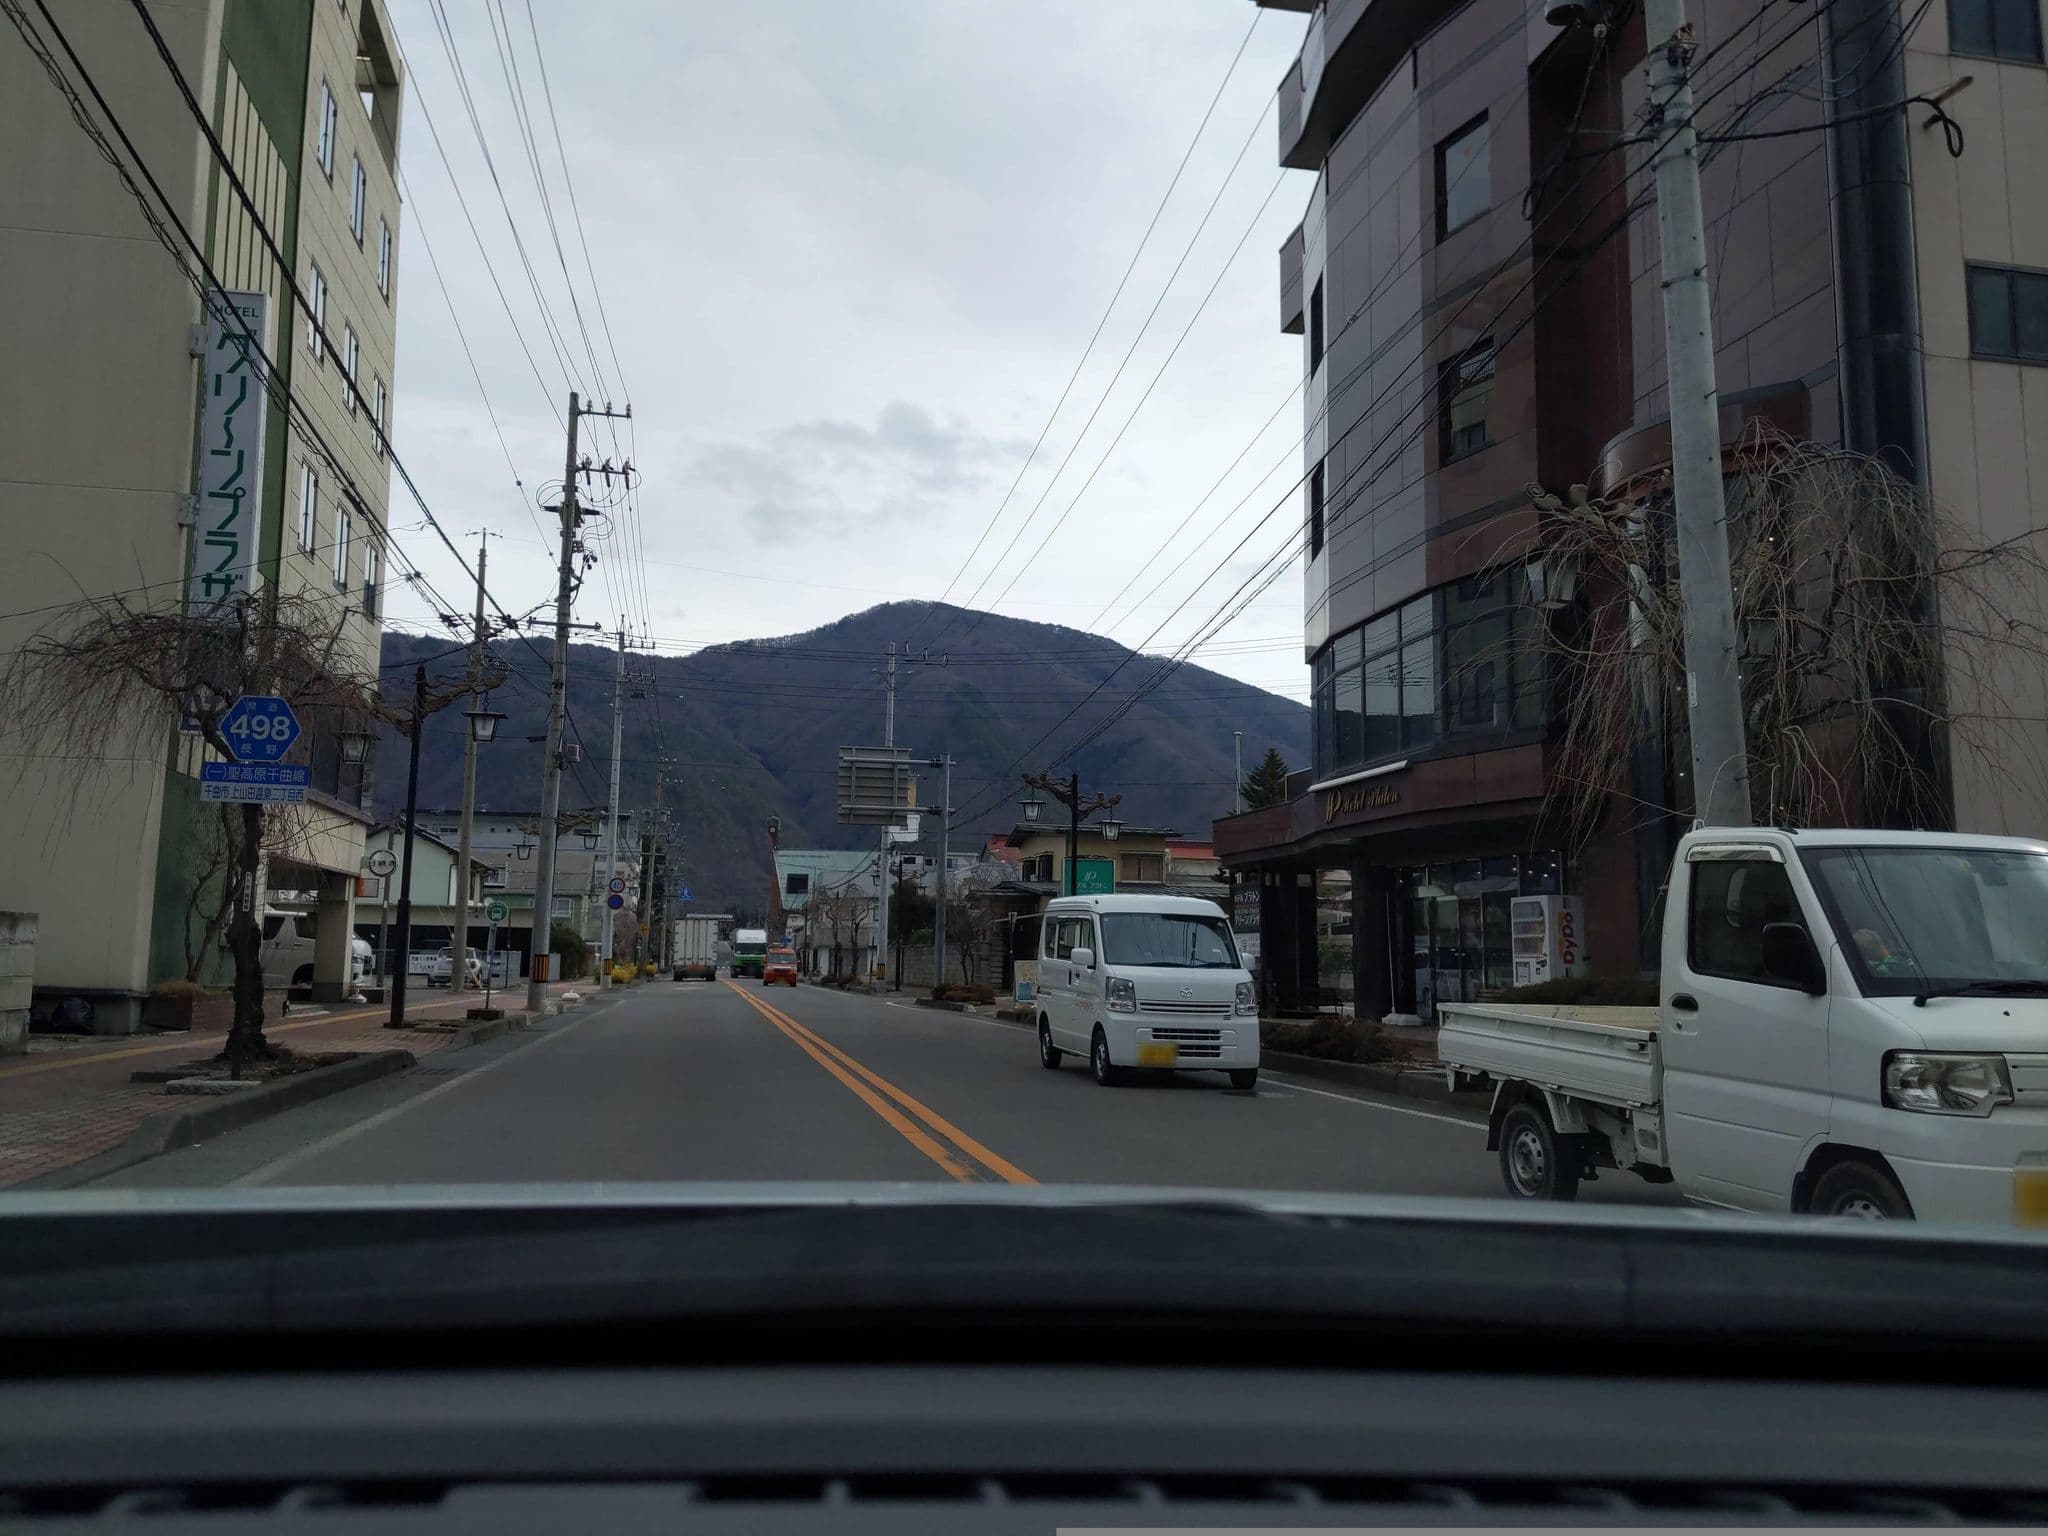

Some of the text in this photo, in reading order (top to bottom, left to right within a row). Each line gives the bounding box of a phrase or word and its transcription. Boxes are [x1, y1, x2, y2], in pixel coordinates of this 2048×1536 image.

[215, 304, 260, 318] HOTEL
[202, 329, 258, 604] グリーンプラザ
[230, 714, 291, 741] 498
[240, 743, 277, 754] 長野
[612, 881, 623, 890] 40
